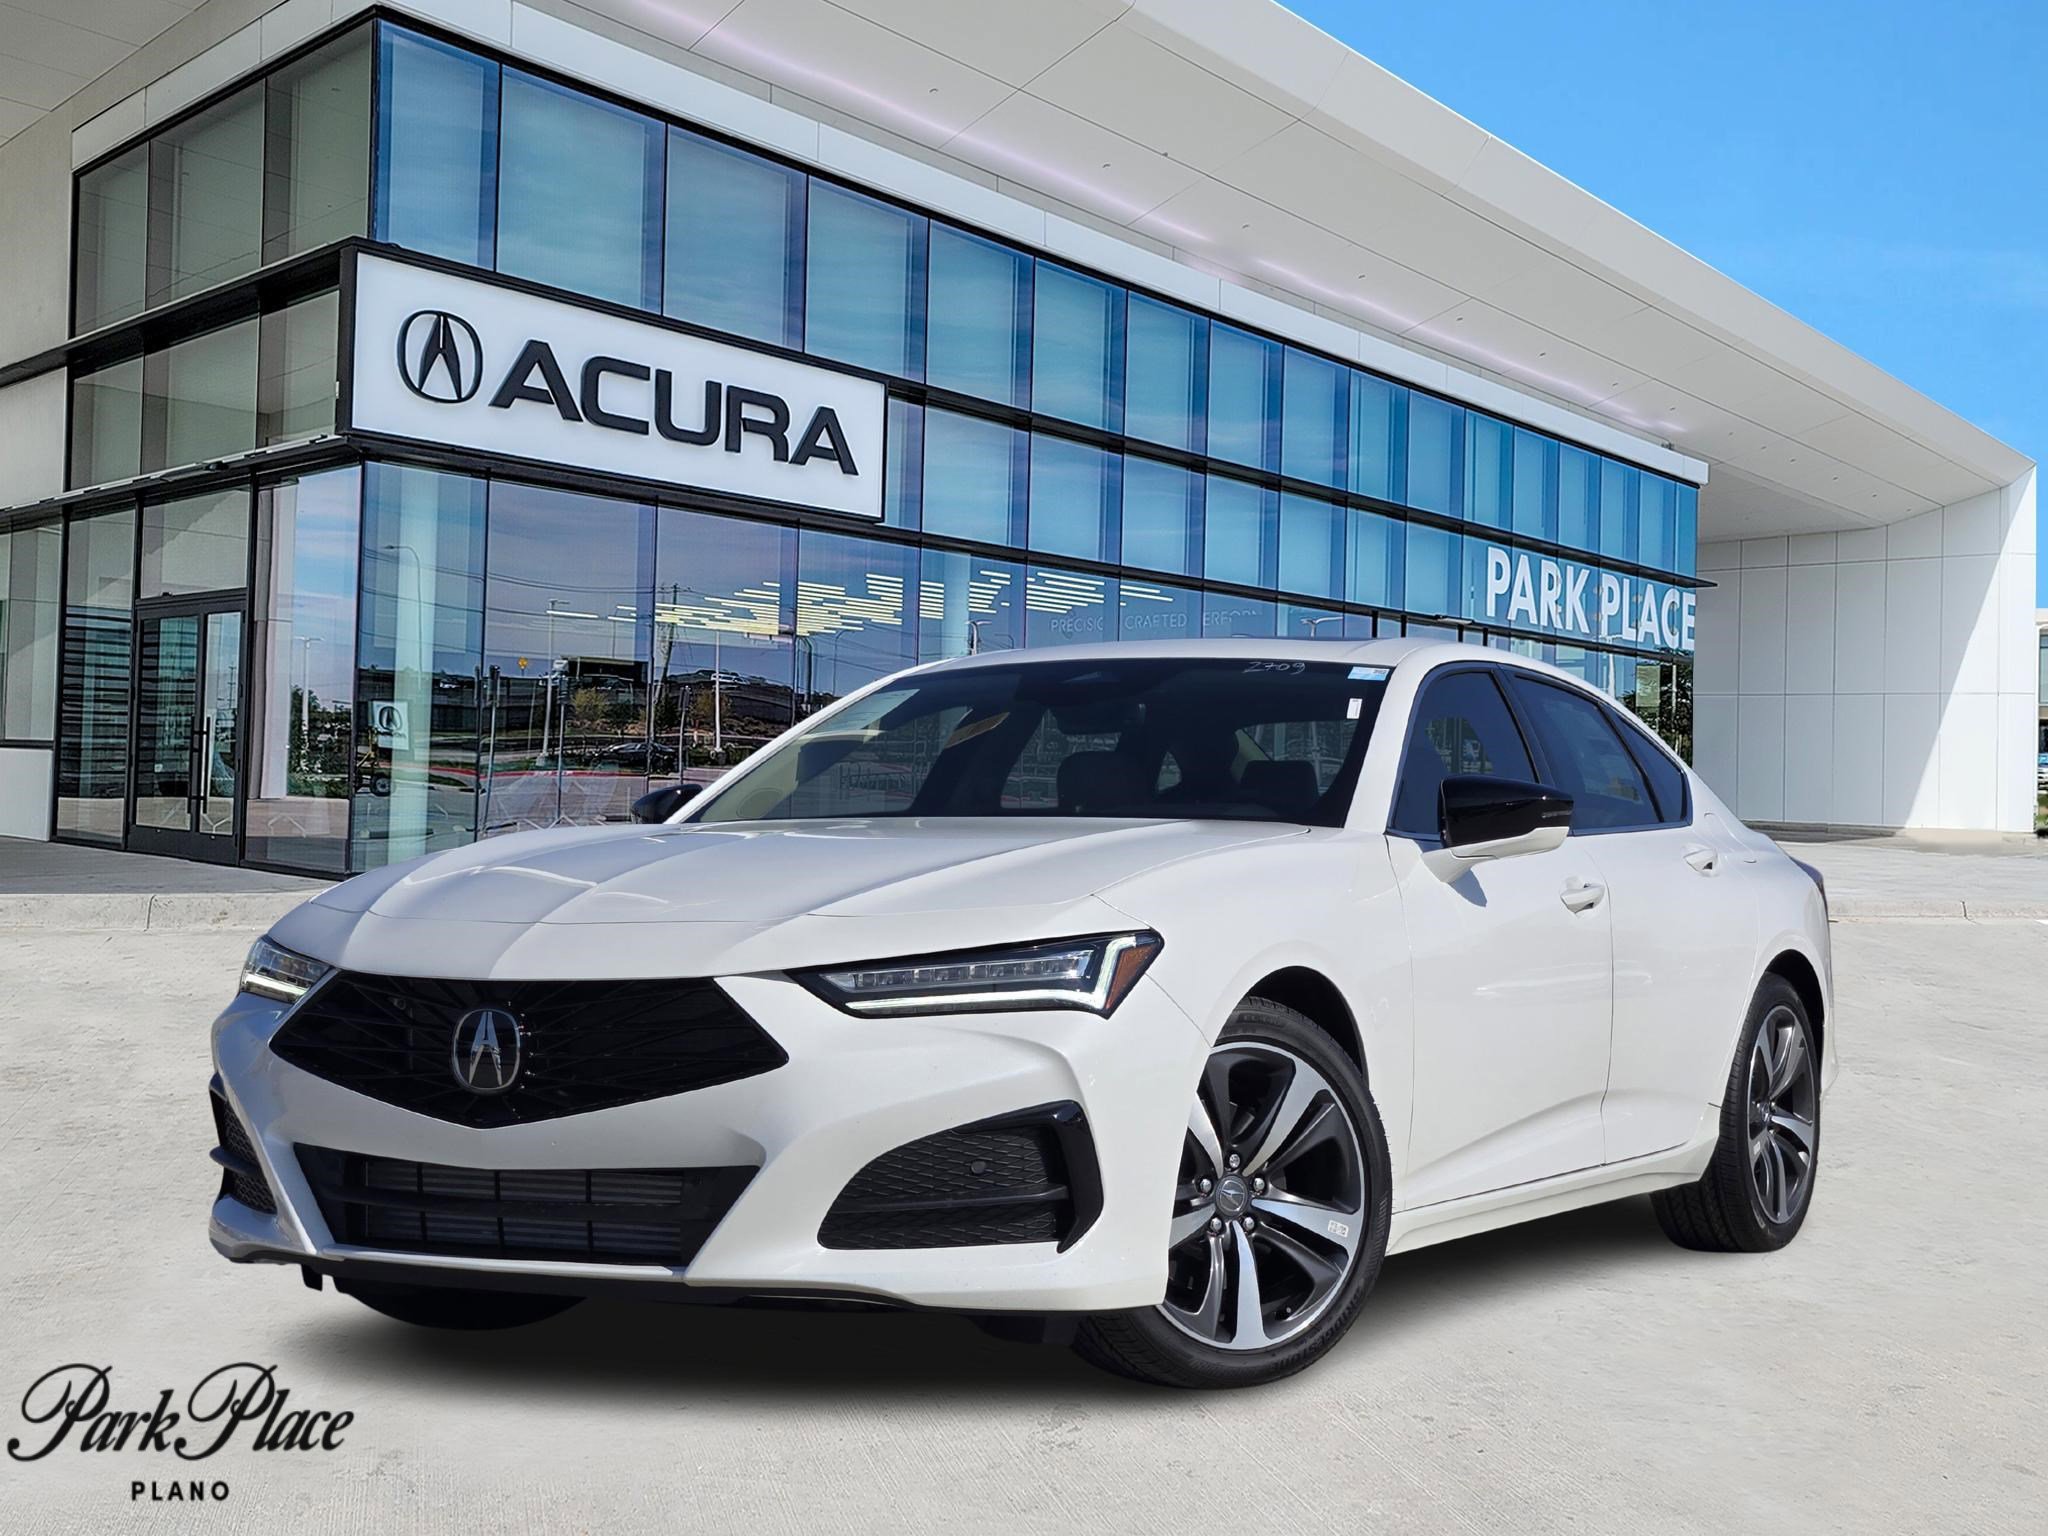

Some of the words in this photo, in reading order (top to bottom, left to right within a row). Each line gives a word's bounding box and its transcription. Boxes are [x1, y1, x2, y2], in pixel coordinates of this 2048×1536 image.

[488, 339, 859, 476] ACURA
[1124, 613, 1187, 630] CRAFTED
[1486, 546, 1590, 634] PARK
[1601, 573, 1696, 650] PLACE
[1242, 661, 1306, 675] 2709
